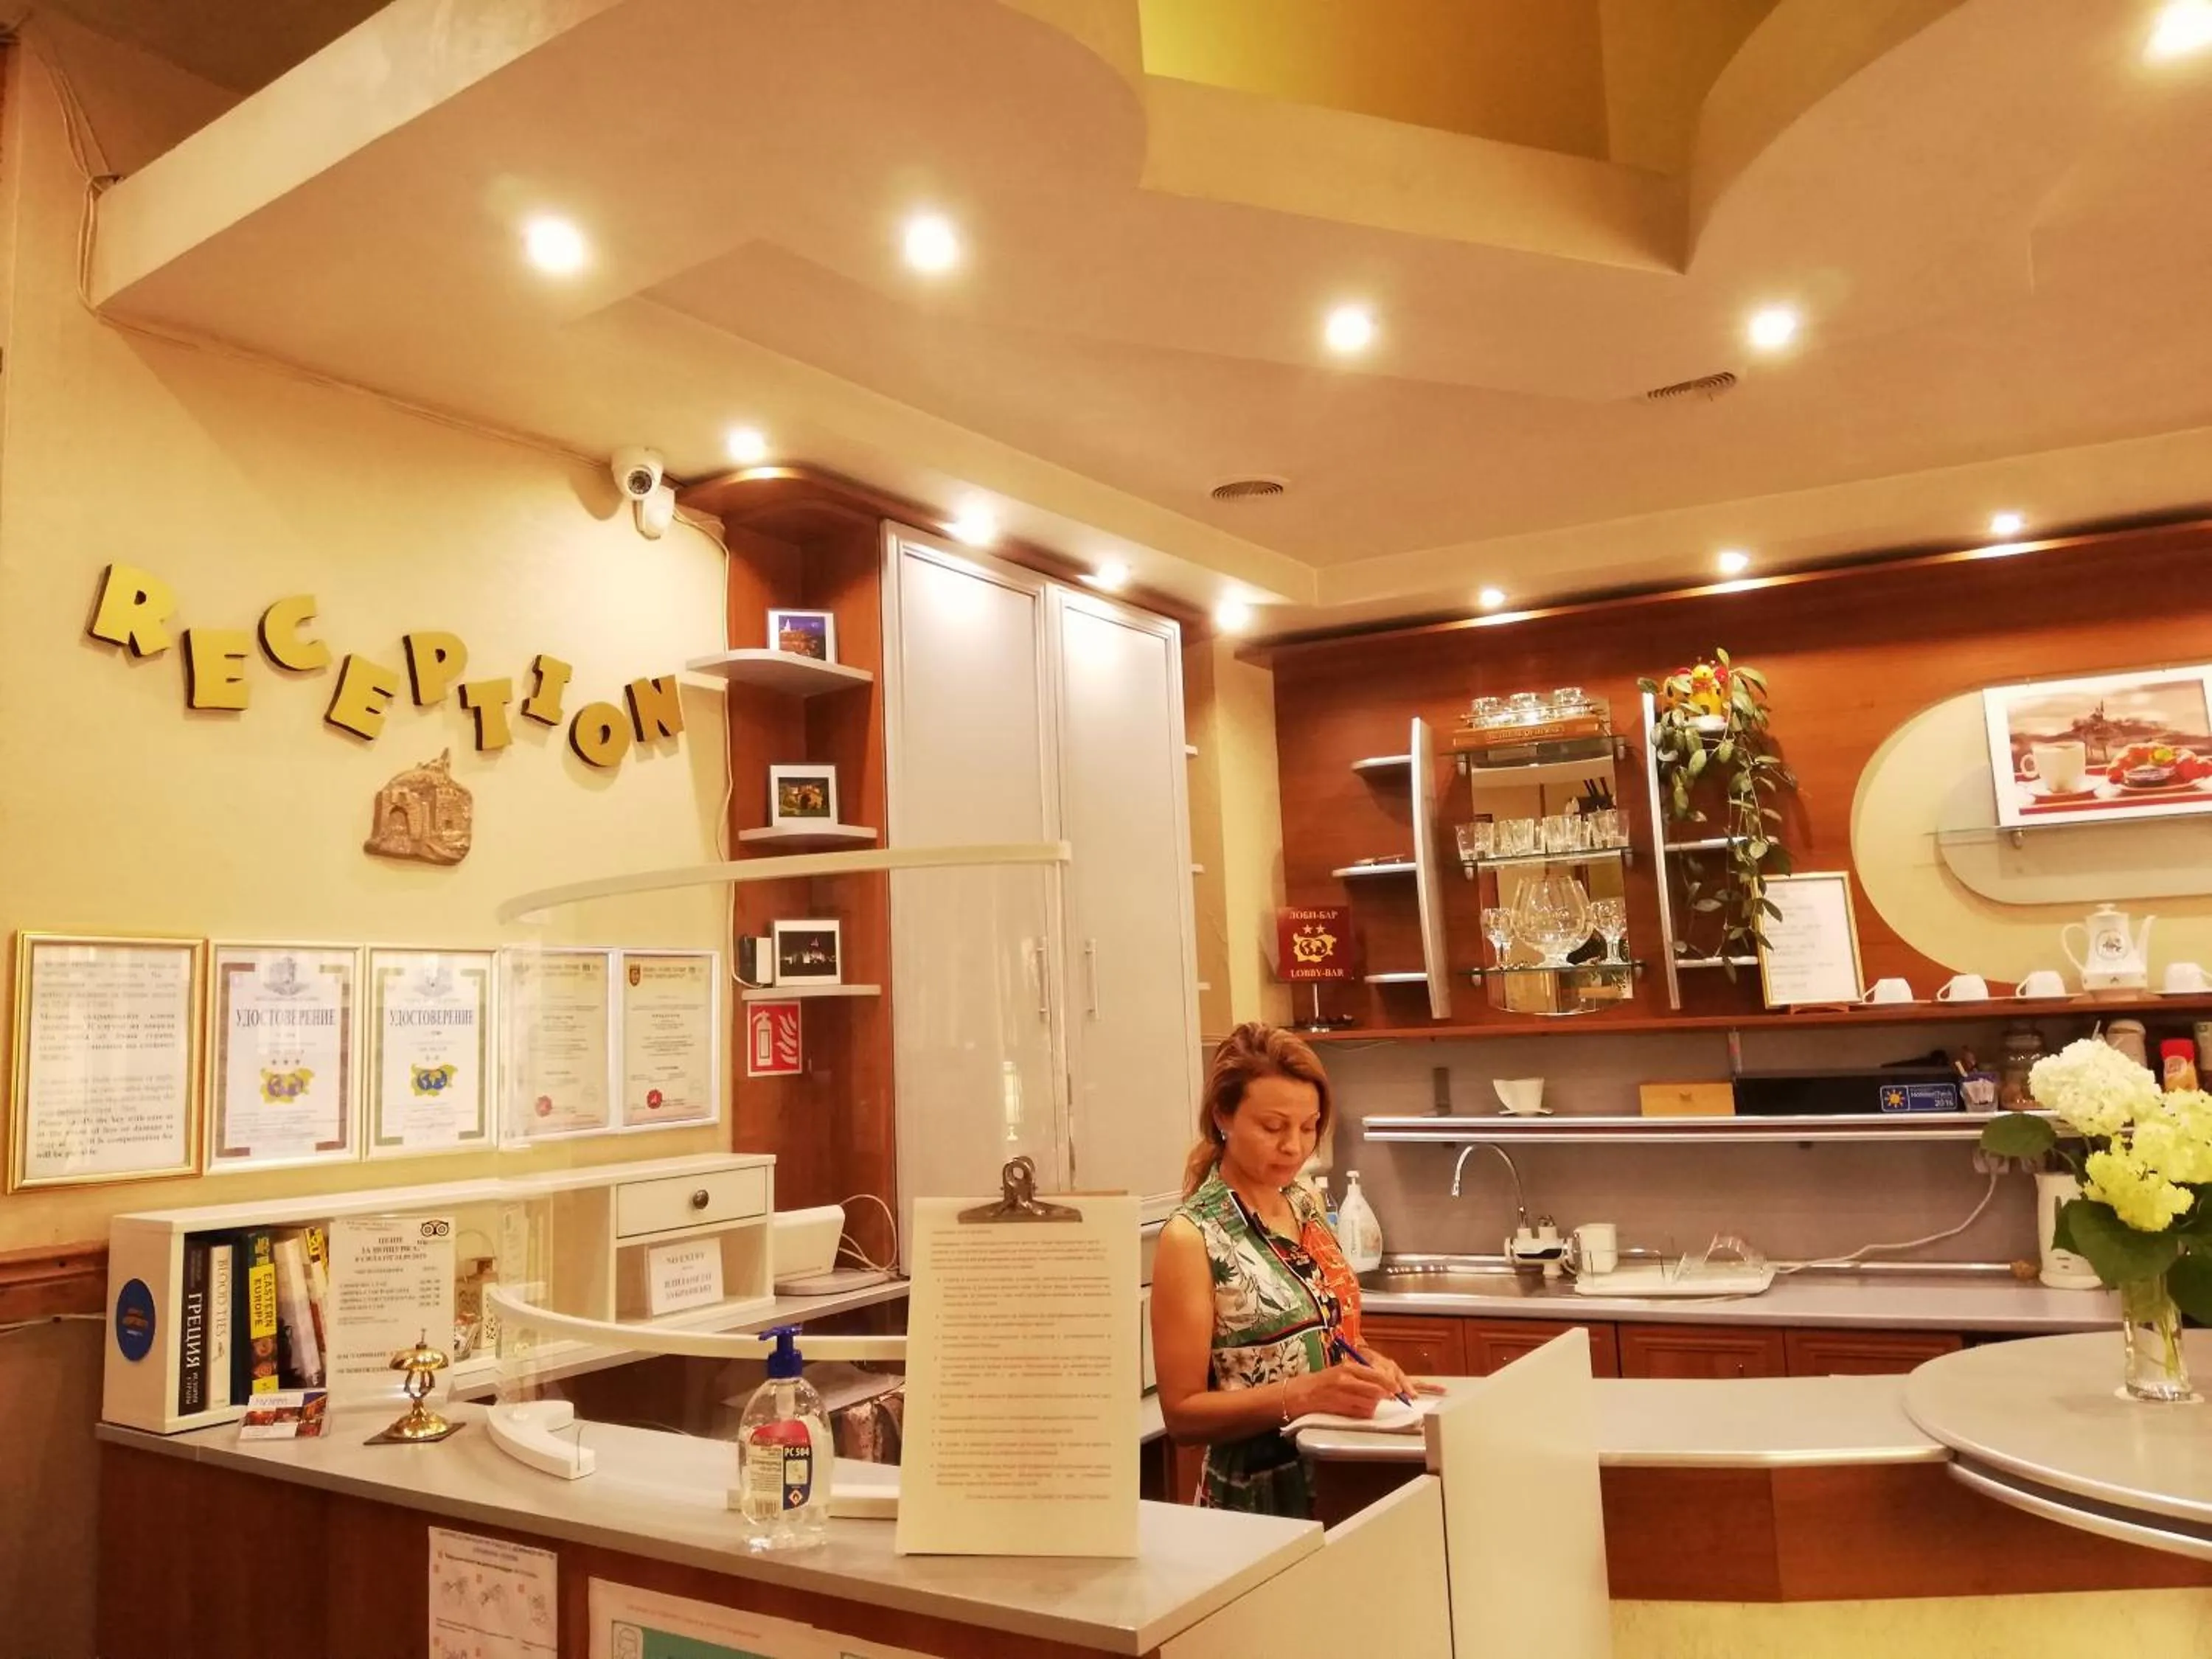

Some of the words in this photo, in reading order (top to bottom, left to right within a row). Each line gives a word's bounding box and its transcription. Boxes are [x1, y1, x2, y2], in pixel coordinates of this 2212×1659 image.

[86, 563, 684, 768] RECEPTION
[1290, 968, 1344, 978] LOBBY-BAR
[389, 1009, 473, 1026] УДОСТОВЕРЕНИЕ
[253, 1277, 263, 1326] EUROPE
[262, 1272, 274, 1328] EASTERN
[186, 1292, 203, 1368] ГРЕЦИЯ
